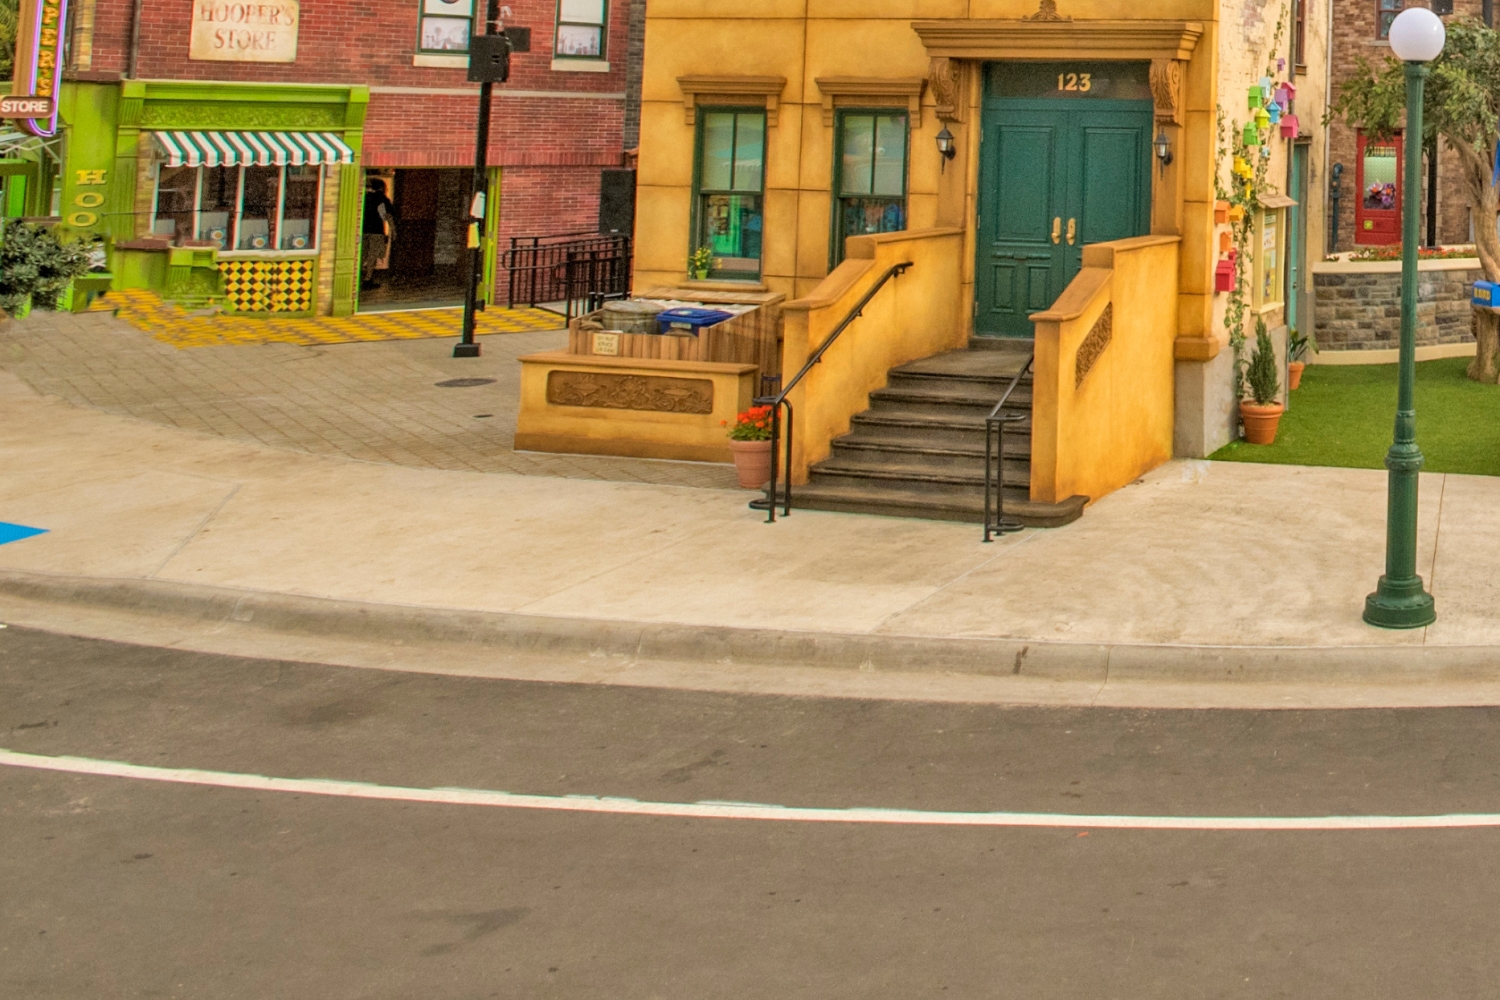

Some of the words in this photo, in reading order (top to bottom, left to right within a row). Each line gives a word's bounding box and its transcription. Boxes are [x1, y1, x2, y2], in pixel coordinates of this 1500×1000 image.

[199, 1, 295, 26] HOOPER'S
[214, 28, 276, 50] STORE
[1058, 73, 1091, 91] 123
[1, 101, 48, 113] STORE
